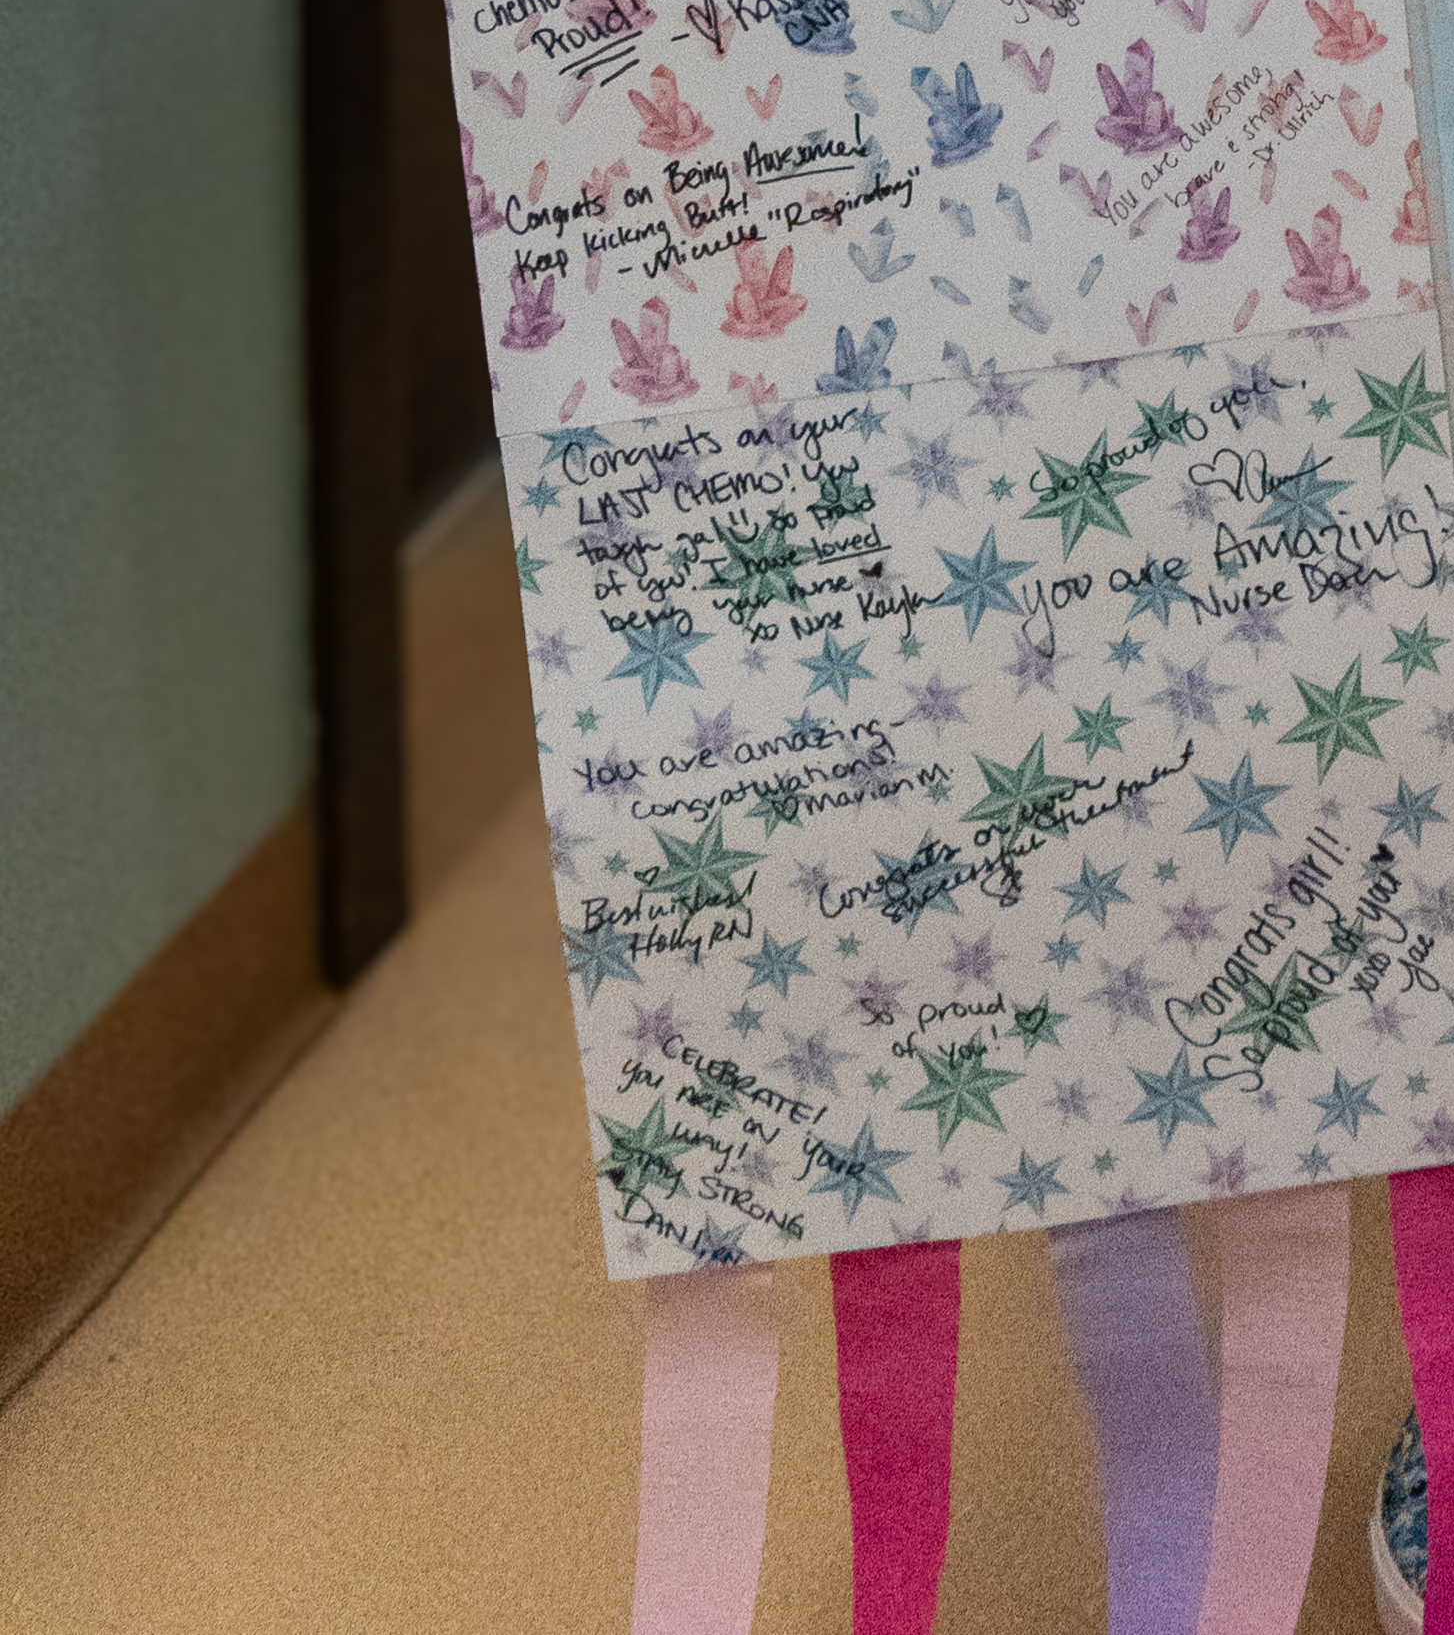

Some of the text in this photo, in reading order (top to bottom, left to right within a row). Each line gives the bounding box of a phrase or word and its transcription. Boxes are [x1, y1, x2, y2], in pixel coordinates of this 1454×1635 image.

[505, 159, 730, 235] Congrats on Being
[1102, 154, 1179, 226] You are
[1167, 160, 1225, 208] brave
[515, 248, 570, 283] Keep
[562, 408, 858, 492] Congrats on your
[579, 486, 650, 526] LAST
[595, 524, 884, 601] of have loved
[1109, 484, 1451, 594] are Amazing!
[786, 576, 853, 605] nurse
[1190, 580, 1292, 626] Nurse
[573, 748, 716, 791] You are
[710, 911, 753, 948] RN
[1165, 901, 1296, 1047] Congrats
[1203, 869, 1407, 1094] So proud of you
[917, 993, 1006, 1034] proud
[892, 1043, 916, 1060] of
[676, 1084, 780, 1145] ARE ON
[699, 1175, 804, 1241] STRONG
